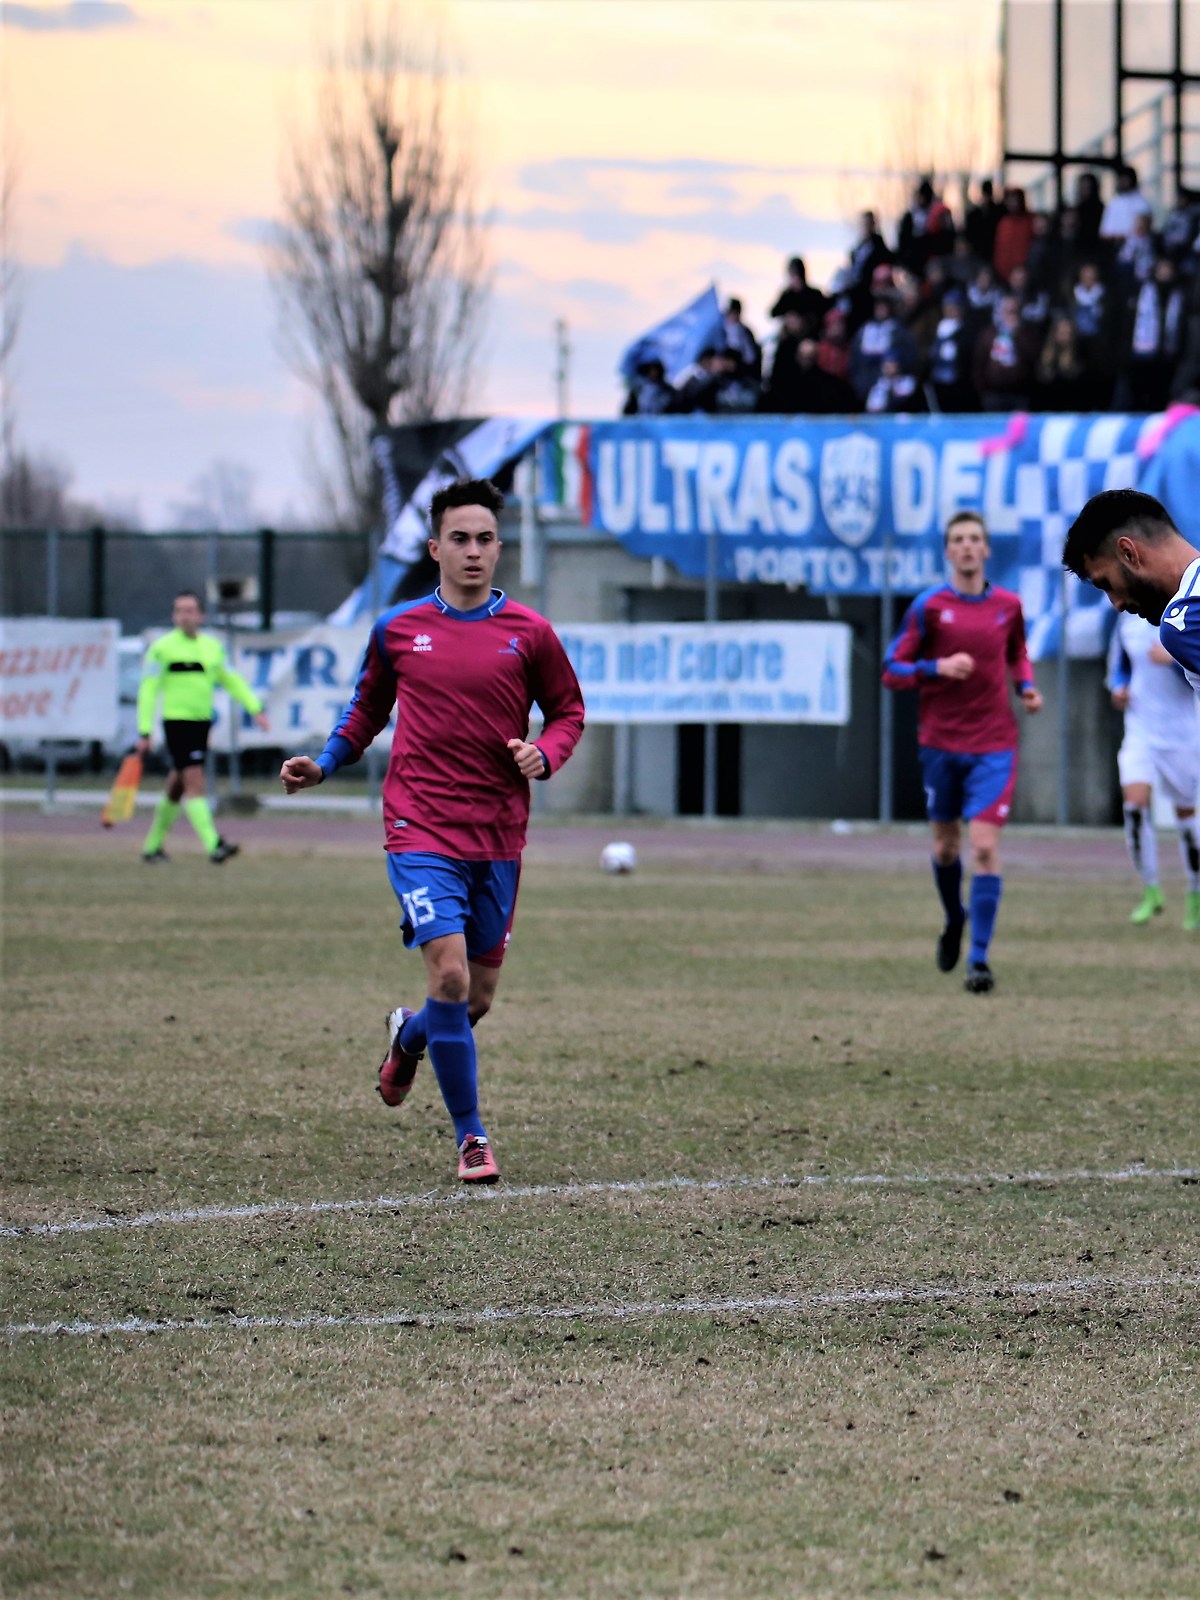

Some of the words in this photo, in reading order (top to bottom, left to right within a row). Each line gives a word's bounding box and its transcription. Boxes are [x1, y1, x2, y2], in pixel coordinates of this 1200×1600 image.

[599, 437, 816, 537] ULTRAS
[891, 437, 1023, 535] DEL
[734, 546, 858, 589] PORTO
[861, 546, 953, 590] TOLL
[0, 628, 112, 677] zzurri
[402, 886, 436, 929] 15
